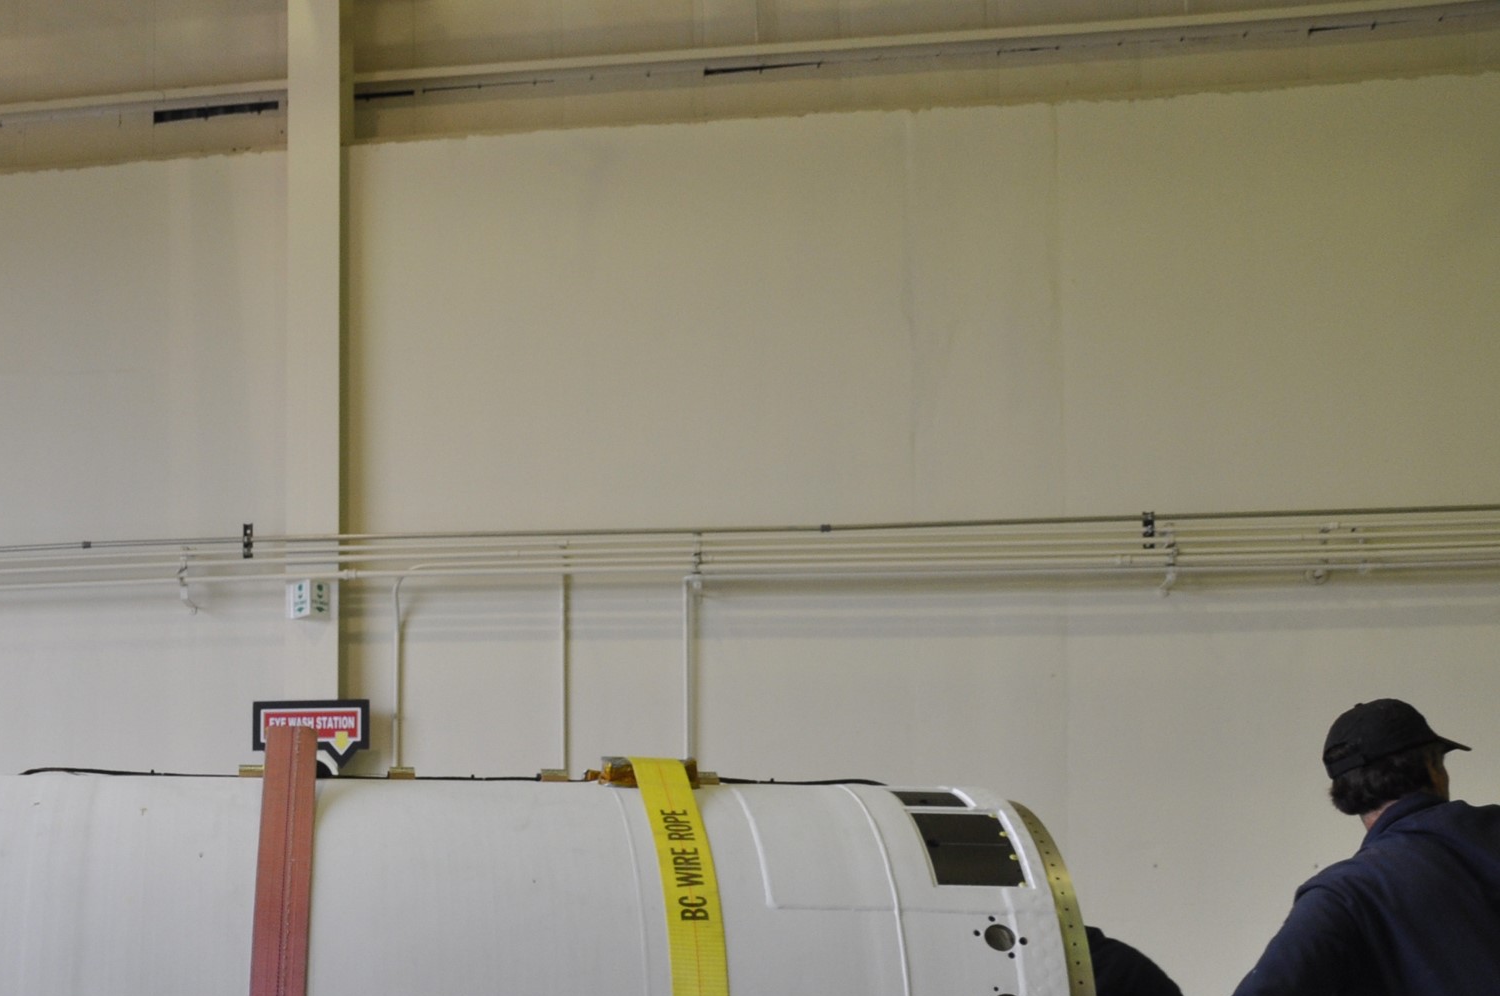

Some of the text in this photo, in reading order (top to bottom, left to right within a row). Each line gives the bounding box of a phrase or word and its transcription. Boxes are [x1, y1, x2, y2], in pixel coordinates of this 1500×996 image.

[316, 716, 355, 730] STATION
[660, 809, 709, 921] BC WIRE ROPE
